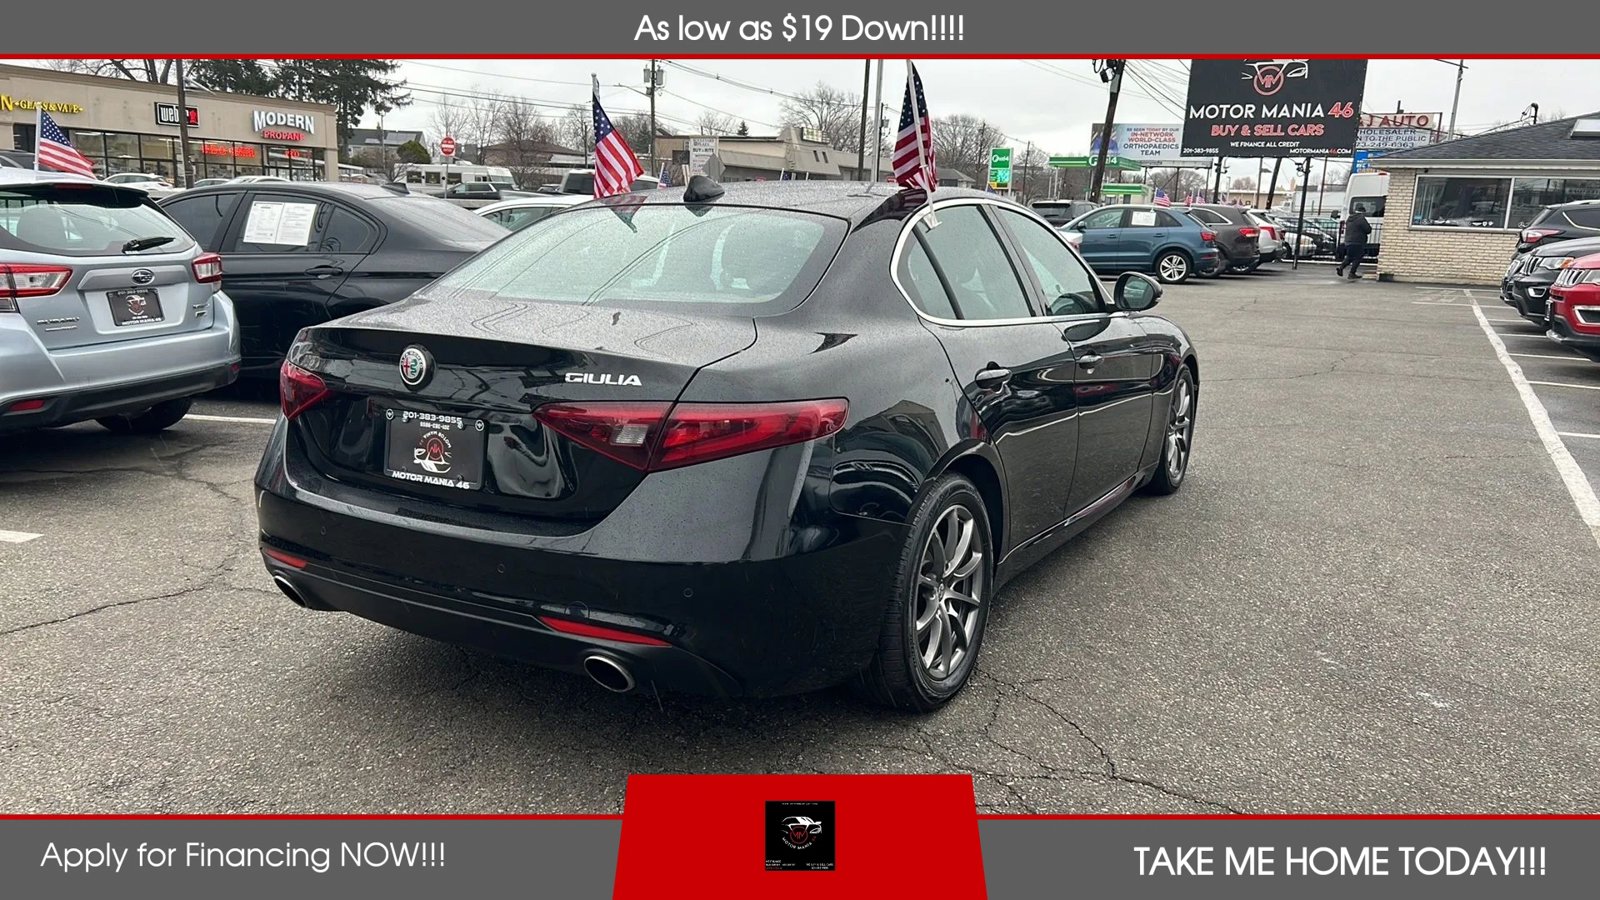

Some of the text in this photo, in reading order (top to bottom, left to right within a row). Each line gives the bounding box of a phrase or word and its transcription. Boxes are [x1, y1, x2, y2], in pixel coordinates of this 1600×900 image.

[1189, 101, 1354, 119] MOTOR MANIA 46
[253, 110, 315, 134] MODERN
[1379, 115, 1429, 127] AUTO
[1211, 123, 1325, 136] BUY & SELL CARS
[565, 372, 642, 387] GIULIA
[392, 471, 423, 482] MOTOR
[424, 475, 455, 487] MANIA
